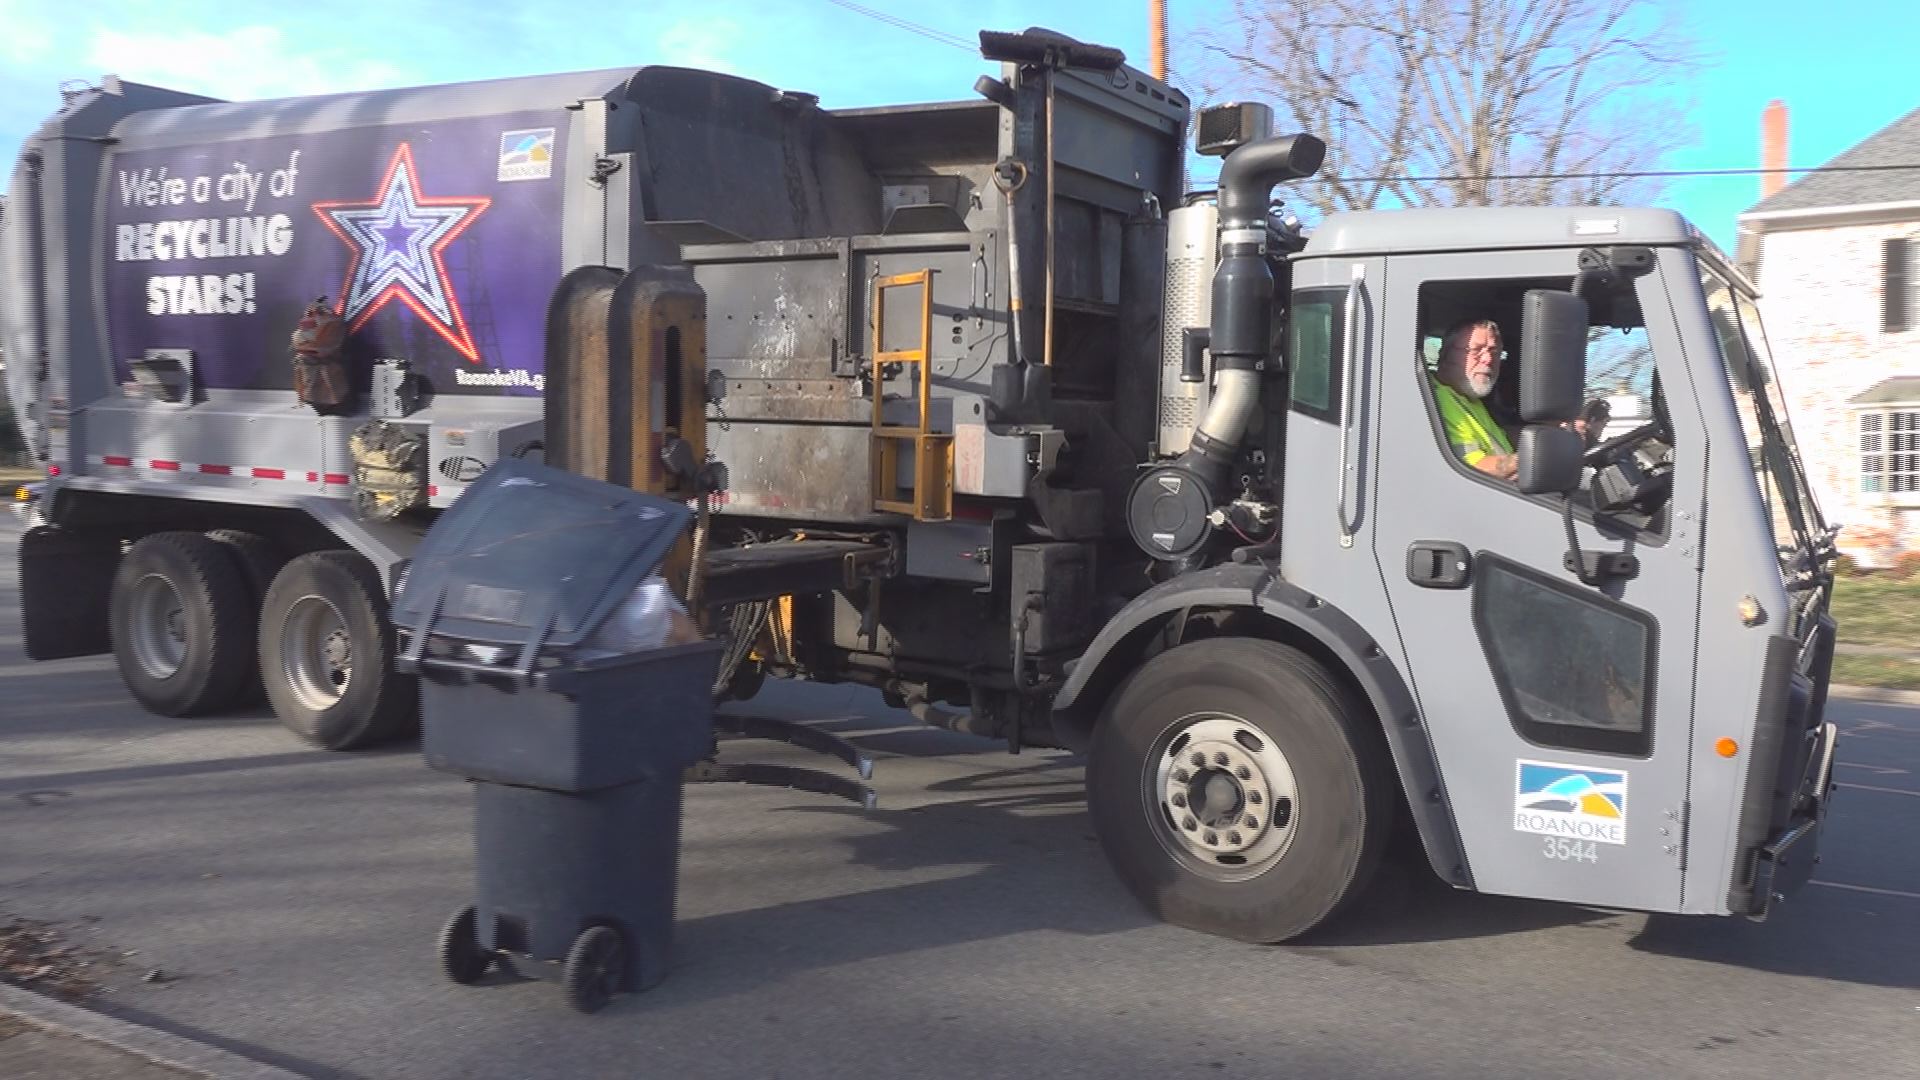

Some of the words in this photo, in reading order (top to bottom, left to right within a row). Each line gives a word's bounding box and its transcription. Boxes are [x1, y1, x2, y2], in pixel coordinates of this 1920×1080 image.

[118, 167, 187, 206] We're
[191, 176, 212, 203] a
[217, 161, 263, 211] city
[268, 150, 301, 197] of
[115, 214, 294, 261] RECYCLING
[146, 272, 257, 315] STARS!
[1517, 813, 1621, 840] ROANOKE
[1543, 836, 1599, 864] 3544
